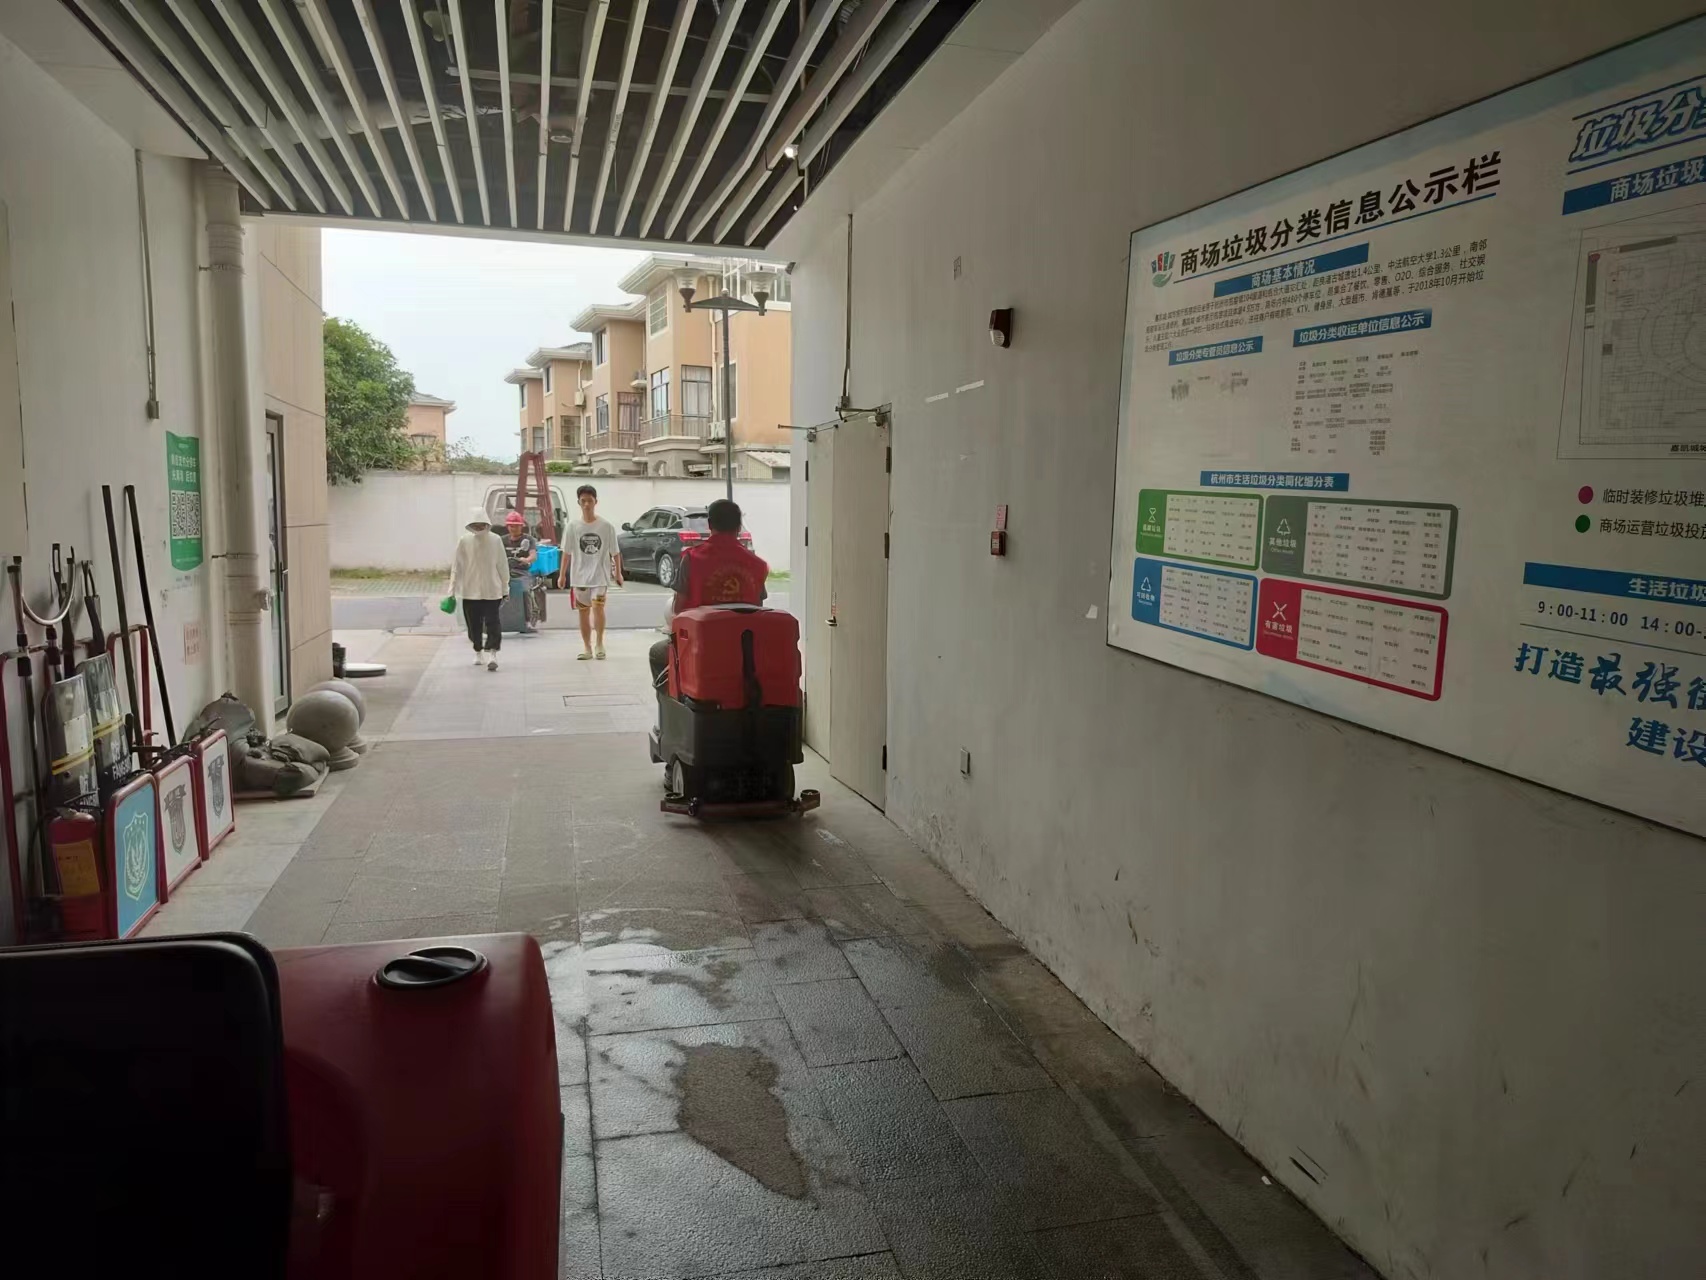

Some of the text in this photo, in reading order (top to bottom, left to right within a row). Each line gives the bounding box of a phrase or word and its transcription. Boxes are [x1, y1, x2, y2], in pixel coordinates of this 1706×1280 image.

[1569, 86, 1706, 162] 垃圾分
[1180, 151, 1501, 276] 商场垃圾分类信息公示栏
[1251, 260, 1316, 288] 商场基本情况
[1299, 314, 1424, 344] 垃圾分类收运单位信息公示
[1211, 473, 1334, 488] 杭州市生活垃圾分类简化细分表
[1602, 488, 1706, 508] 临时装修垃圾堆
[1269, 537, 1297, 548] 其他垃圾
[1265, 620, 1293, 633] 有害垃圾
